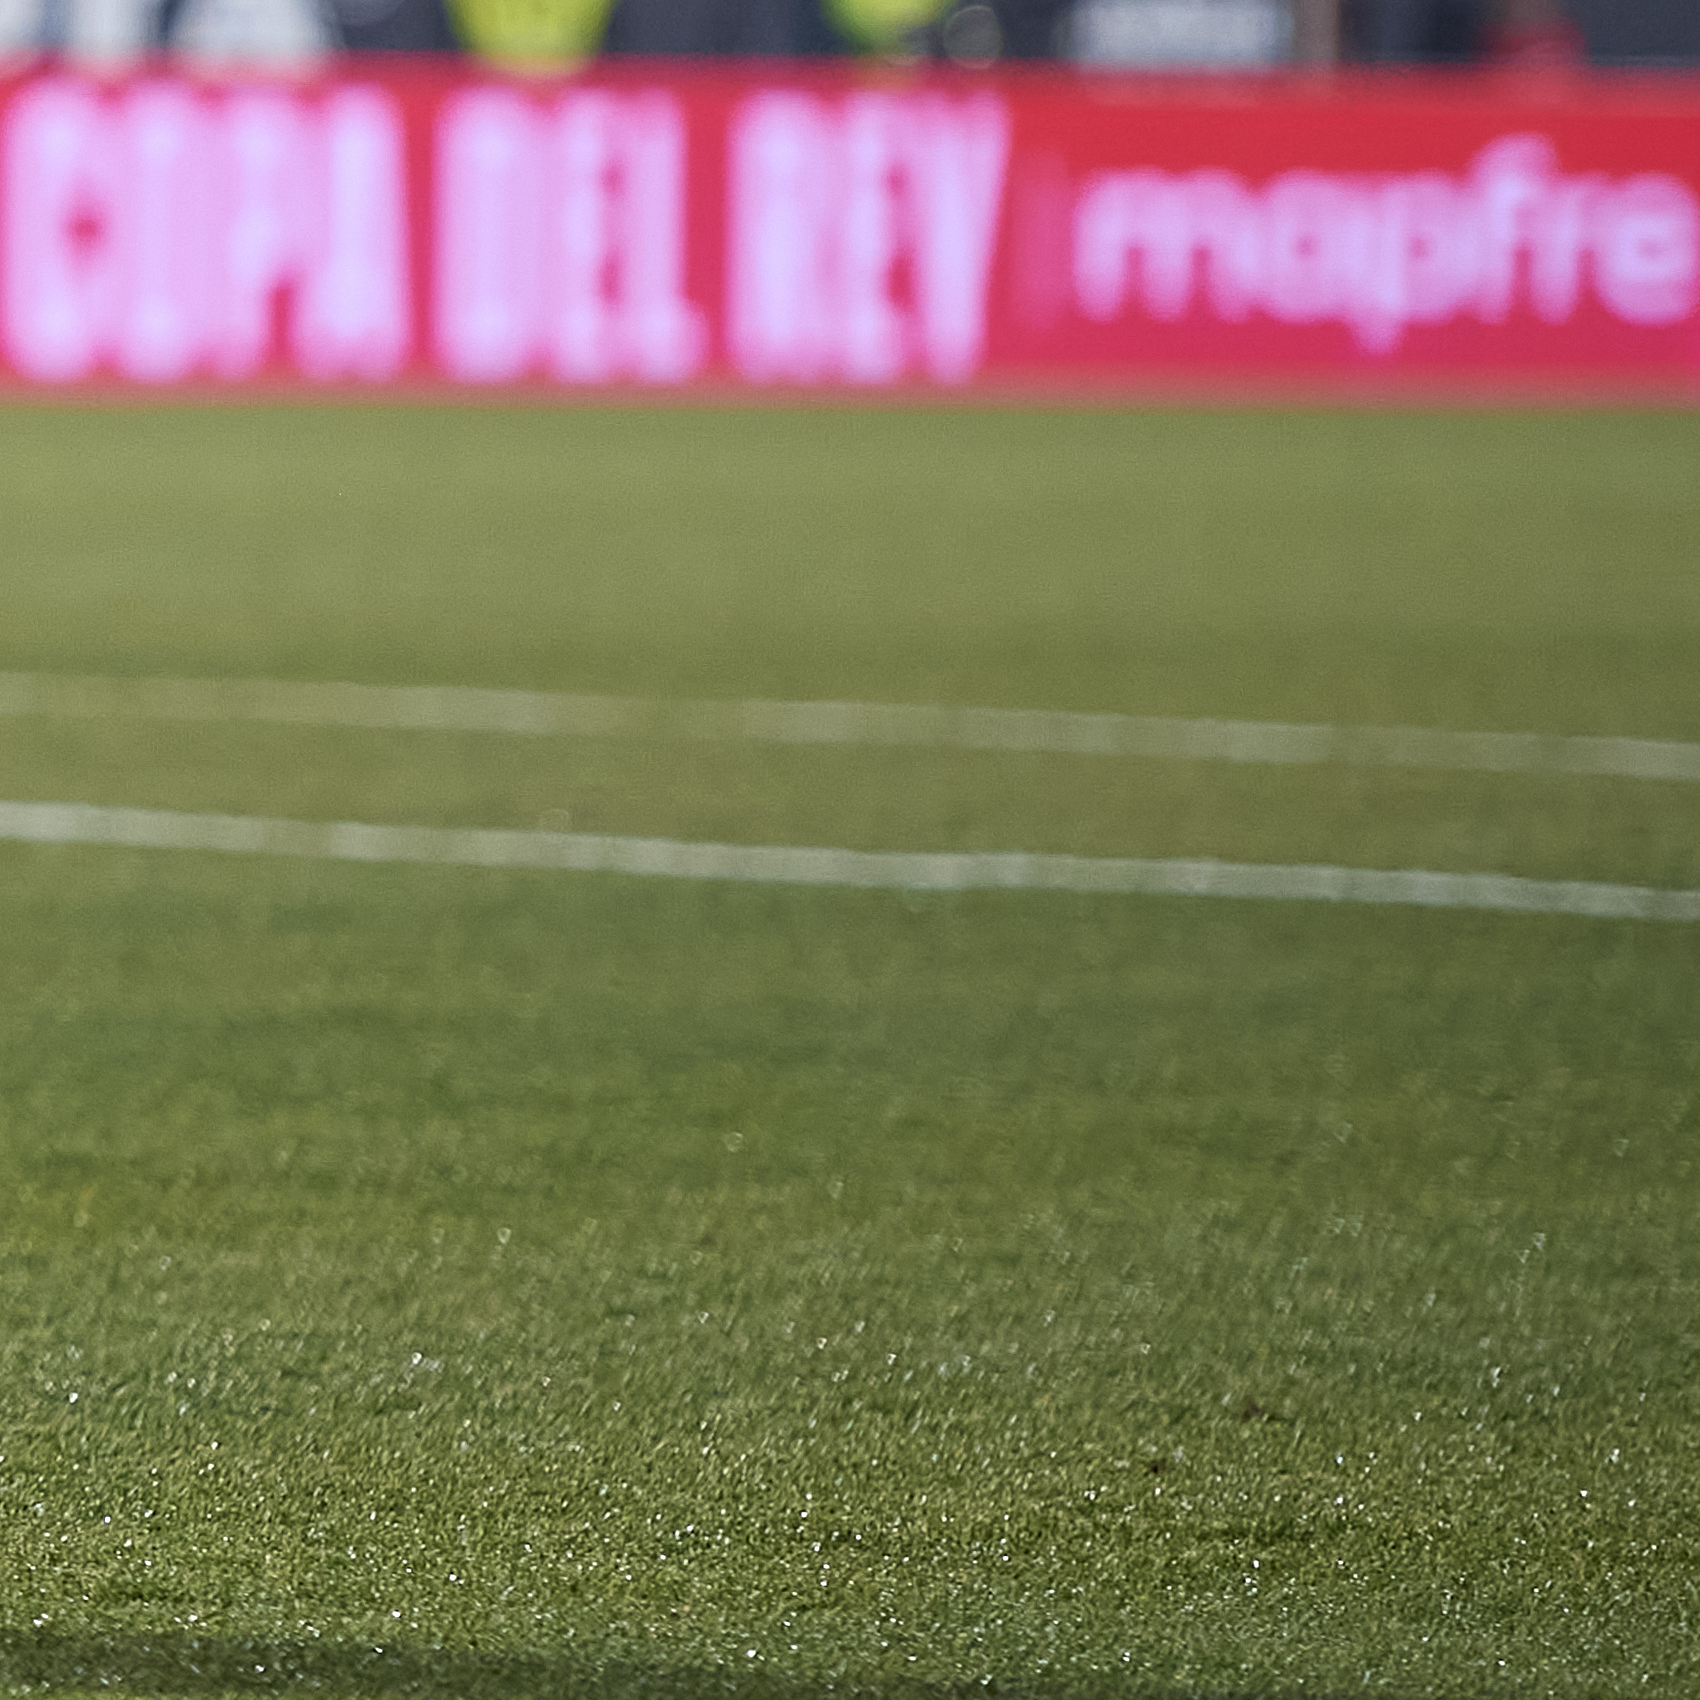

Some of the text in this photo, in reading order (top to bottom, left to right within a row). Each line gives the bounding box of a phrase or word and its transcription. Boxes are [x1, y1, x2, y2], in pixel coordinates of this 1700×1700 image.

[434, 82, 706, 386] DEL
[724, 88, 1010, 386] REY
[1070, 130, 1698, 356] mapfre
